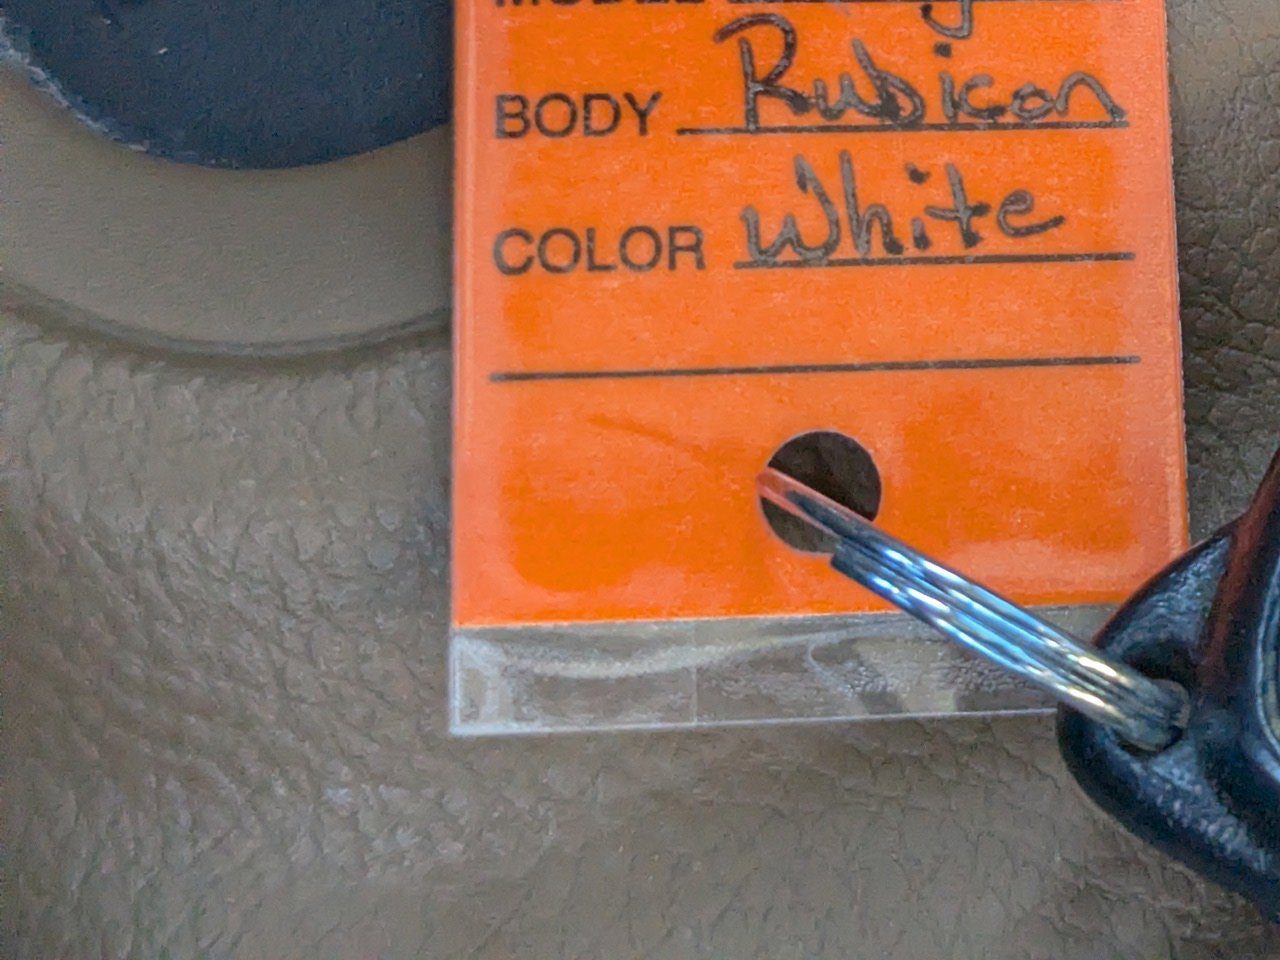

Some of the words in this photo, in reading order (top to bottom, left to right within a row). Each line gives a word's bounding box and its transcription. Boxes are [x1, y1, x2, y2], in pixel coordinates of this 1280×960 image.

[714, 12, 1130, 132] Rubicon
[495, 90, 663, 138] BODY
[740, 149, 1067, 256] White
[492, 225, 707, 275] COLOR
